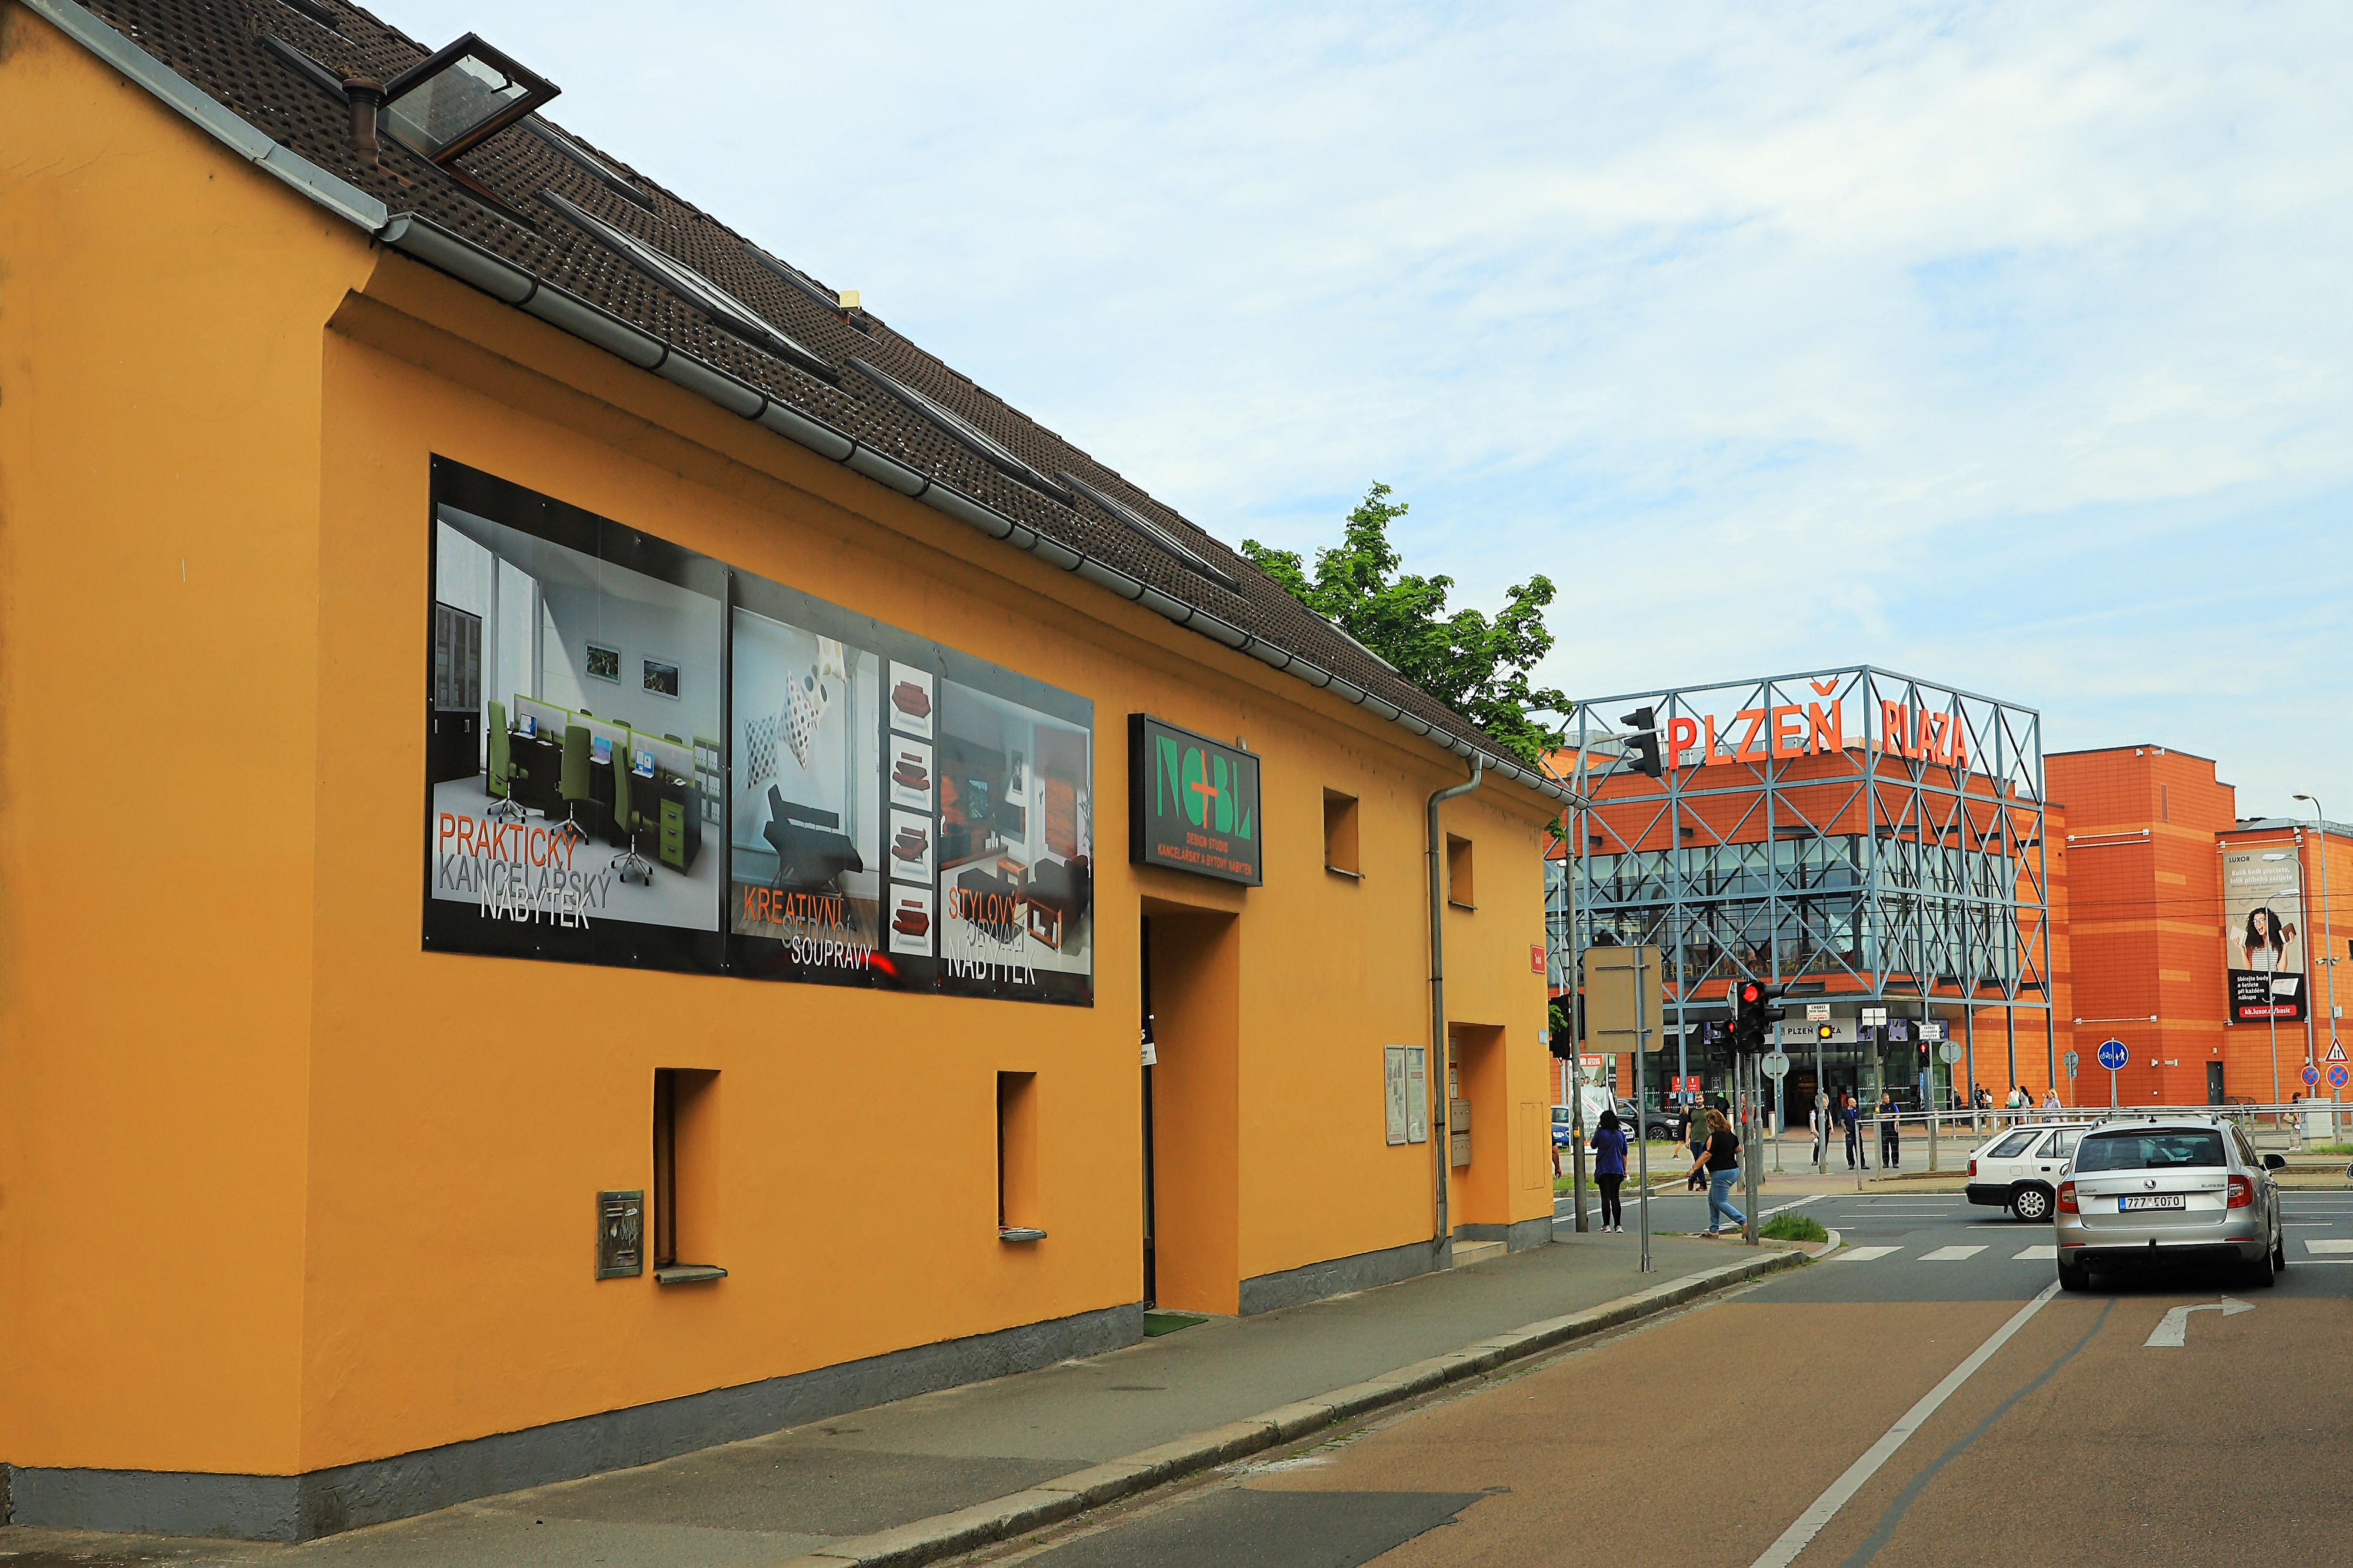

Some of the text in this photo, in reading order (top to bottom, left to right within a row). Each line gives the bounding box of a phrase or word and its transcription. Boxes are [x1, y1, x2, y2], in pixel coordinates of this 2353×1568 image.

[1668, 679, 1969, 770] PLZEŇ PLAZA
[1156, 735, 1251, 840] NOBL
[439, 812, 578, 870] PRAKTICKÝ
[1158, 843, 1252, 875] KANCELÁŘSKÝ A BYTOVÝ NÁBYTEK
[1187, 832, 1228, 852] DESIGN STUDIO
[439, 852, 611, 908] KANCELÁŘSKÝ
[481, 873, 589, 929] NÁBYTEK
[744, 886, 843, 932] KREATIVNÍ
[949, 886, 1018, 927] STYLOVÝ
[782, 913, 851, 952] SEDACÍ
[791, 935, 872, 970] SOUPRAVY
[1788, 1026, 1813, 1035] PLZEŇ
